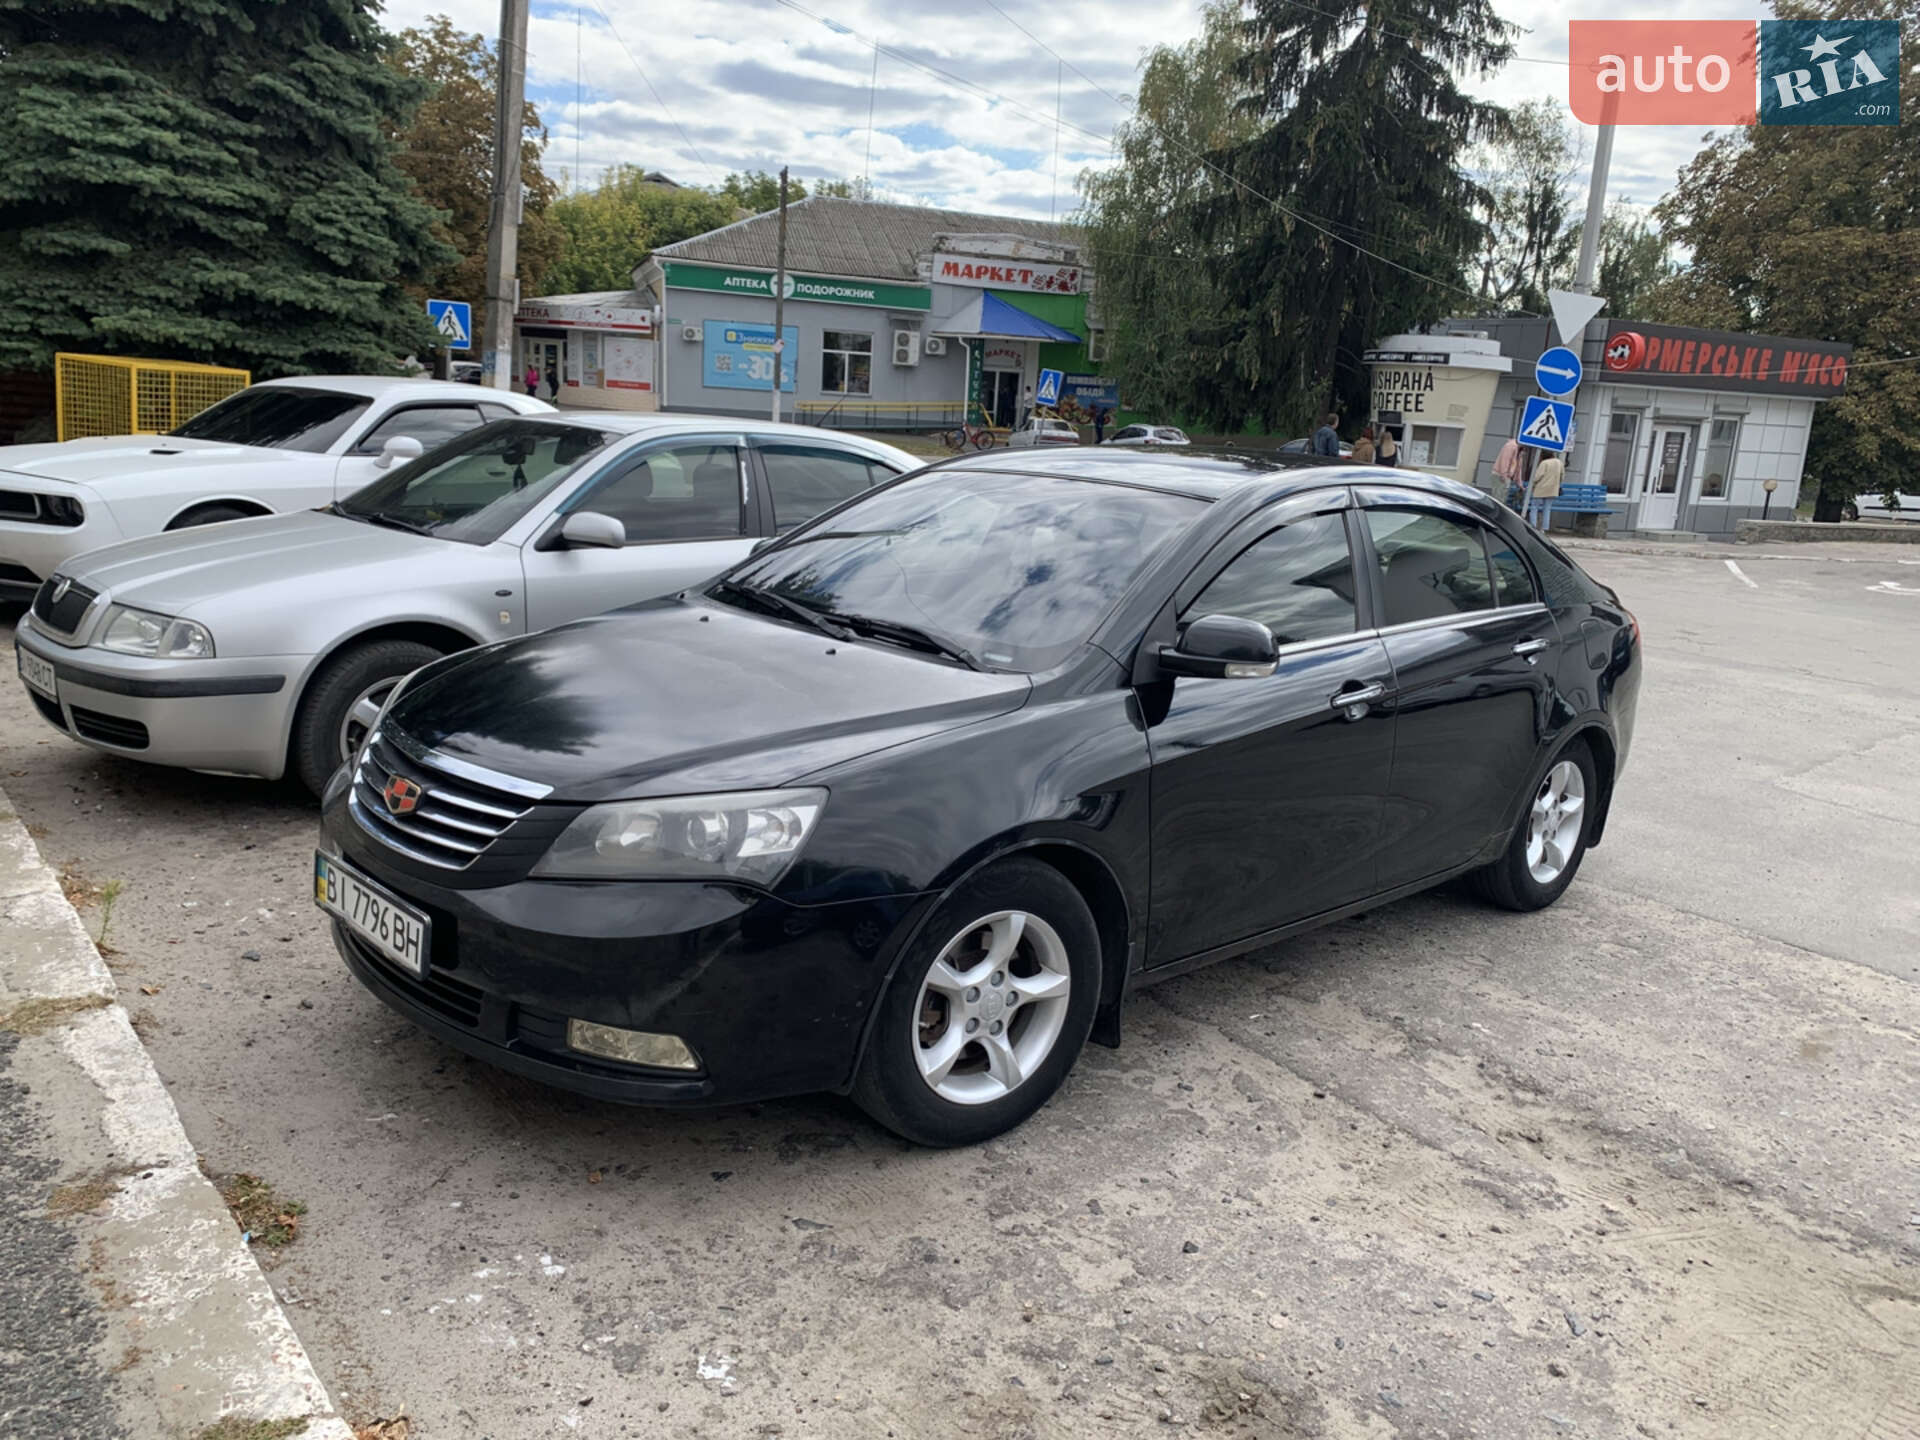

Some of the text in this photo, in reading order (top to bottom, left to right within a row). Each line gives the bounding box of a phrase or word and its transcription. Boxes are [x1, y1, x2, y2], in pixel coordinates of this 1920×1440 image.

[941, 261, 1034, 285] МАРКЕТ
[723, 276, 876, 299] АПТЕКА ПОДОРОЖНИК
[517, 306, 550, 319] ПТЕКА
[1779, 350, 1848, 388] М'ЯСО
[1372, 391, 1425, 413] COFFEE
[353, 884, 389, 941] 7796
[393, 912, 420, 965] BH
